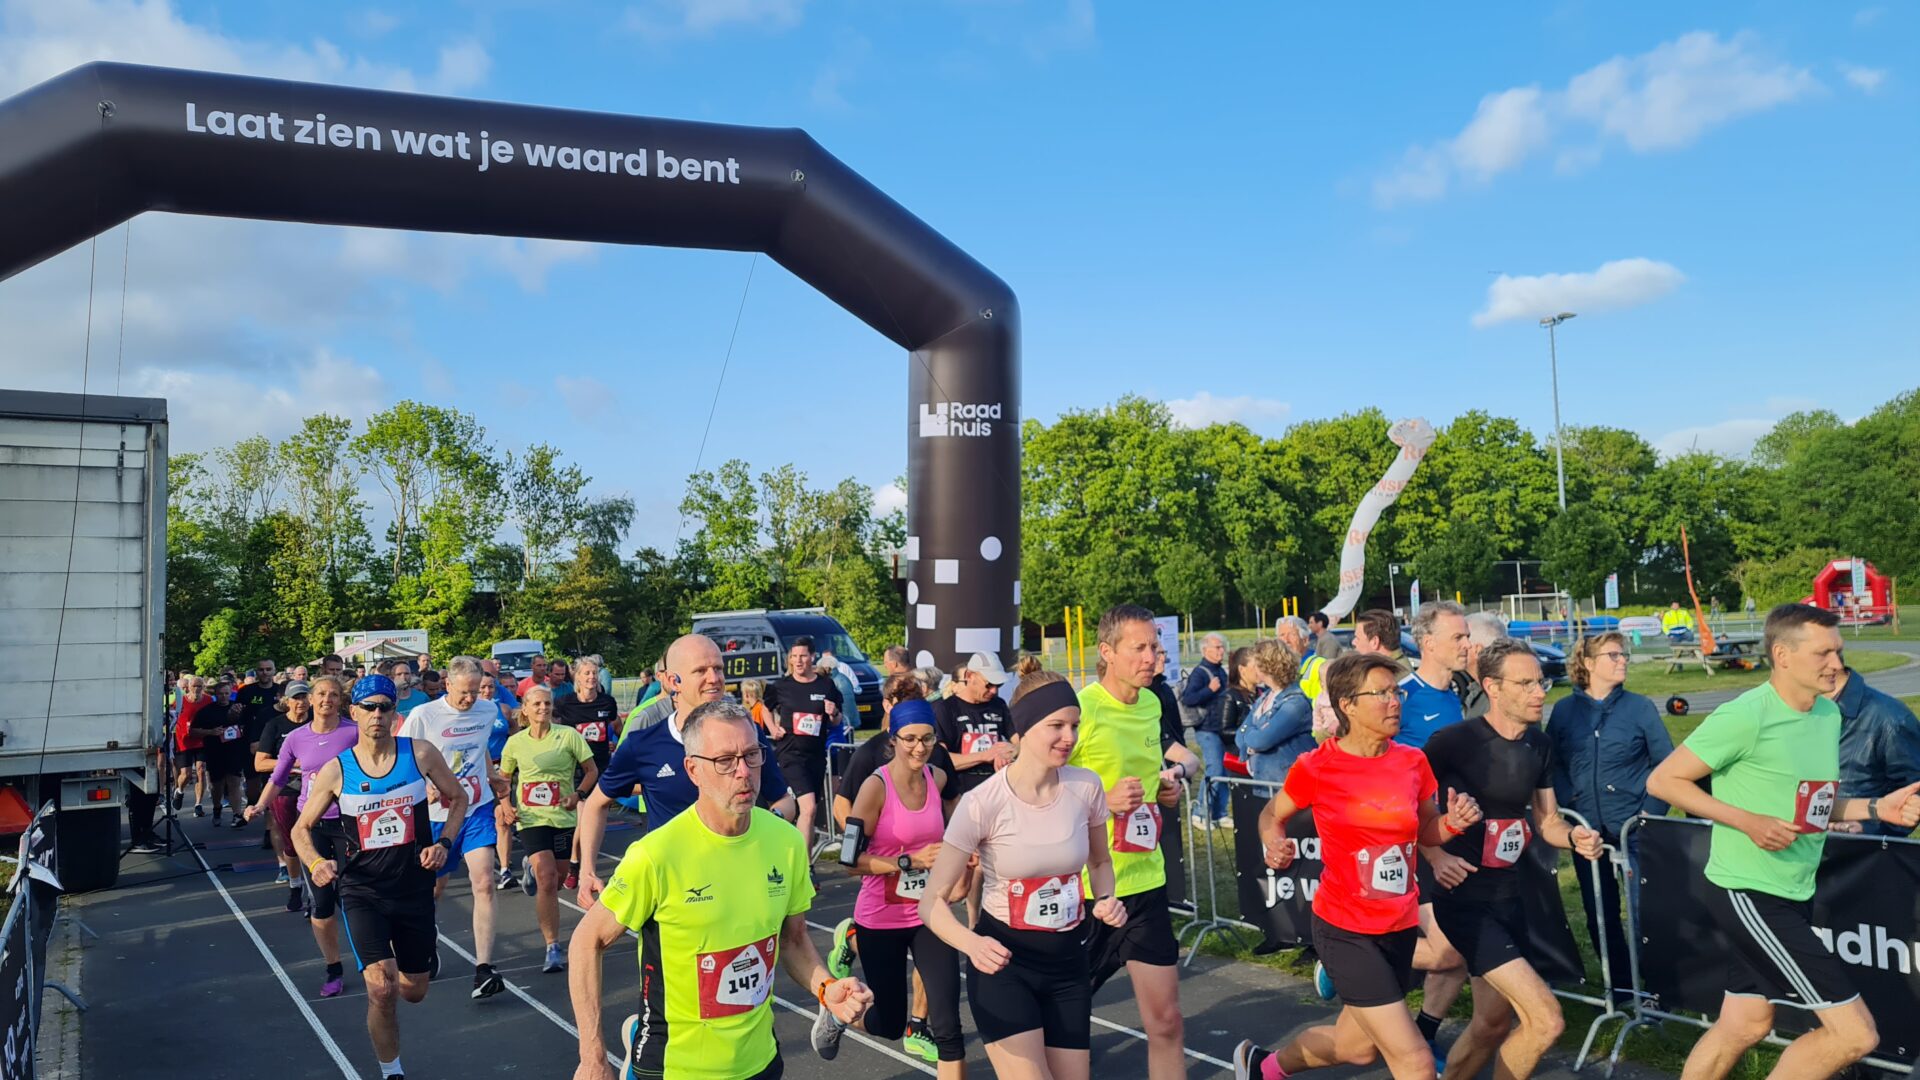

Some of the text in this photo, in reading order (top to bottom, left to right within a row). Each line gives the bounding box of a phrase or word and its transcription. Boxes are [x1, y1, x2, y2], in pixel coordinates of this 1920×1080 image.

[186, 102, 740, 185] Laat zien wat je waard bent
[950, 402, 1002, 419] Raad
[950, 419, 992, 437] huis
[1811, 804, 1831, 816] 190
[377, 825, 399, 837] 191
[1136, 825, 1149, 836] 13
[1502, 840, 1520, 852] 195
[1379, 867, 1403, 882] 424
[903, 878, 926, 891] 179
[1265, 868, 1295, 908] je
[1039, 902, 1059, 916] 29
[728, 972, 760, 994] 147
